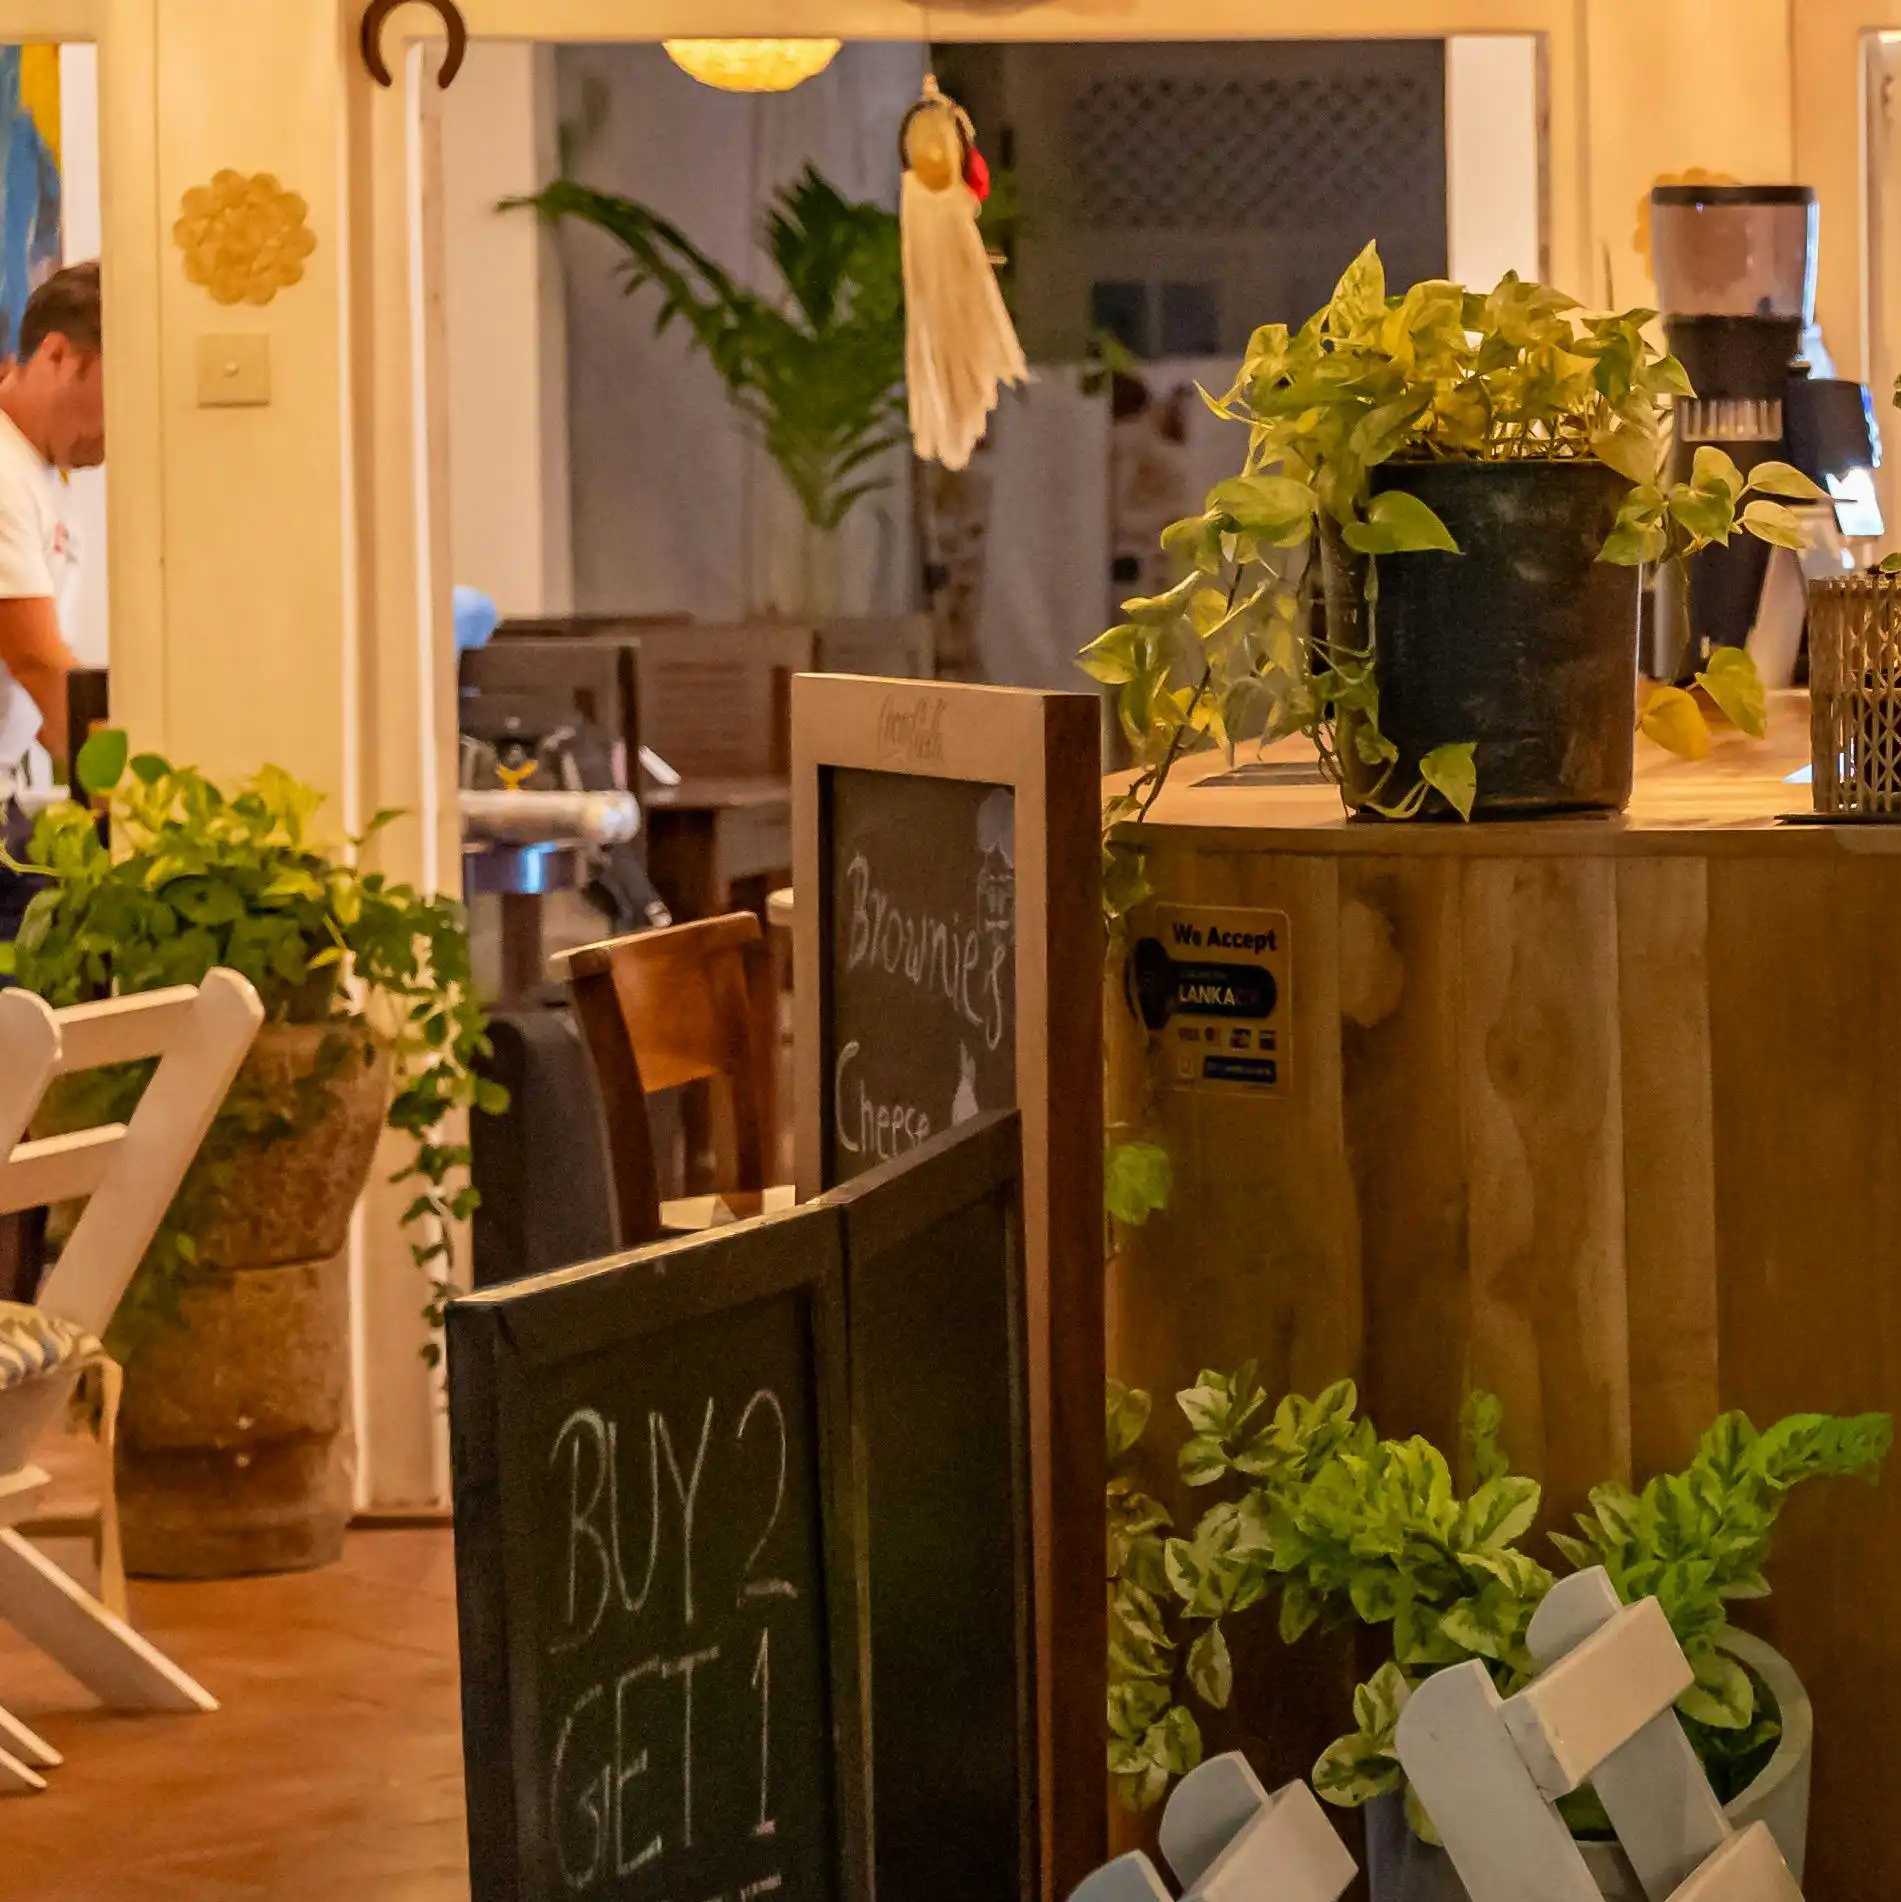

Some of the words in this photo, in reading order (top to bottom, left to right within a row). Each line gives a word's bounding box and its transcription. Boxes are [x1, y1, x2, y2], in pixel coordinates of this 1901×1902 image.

[1172, 922, 1203, 946] We
[1206, 926, 1278, 955] Accept
[1178, 983, 1261, 1007] LANKA
[835, 1040, 931, 1160] Cheese
[549, 1396, 715, 1655] BUY
[735, 1388, 799, 1608] 2
[549, 1646, 721, 1891] GET
[749, 1625, 775, 1838] 1
